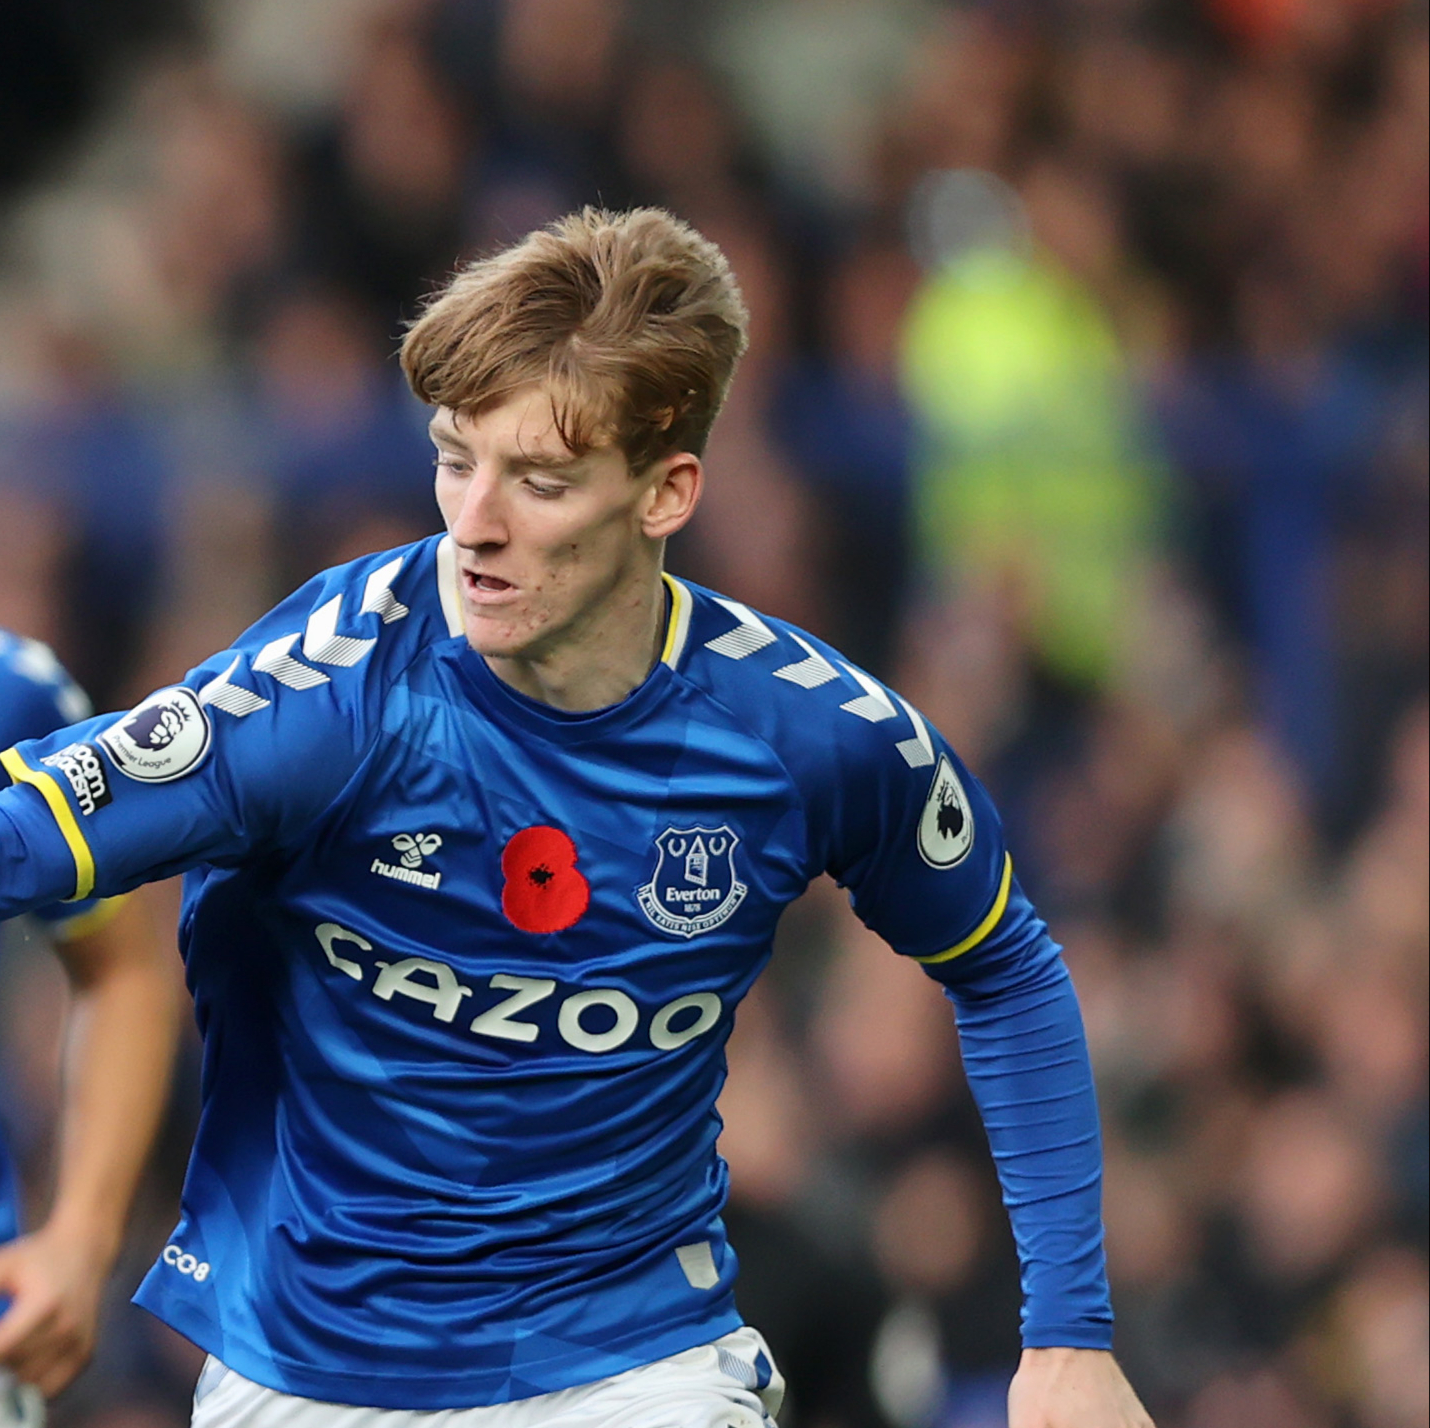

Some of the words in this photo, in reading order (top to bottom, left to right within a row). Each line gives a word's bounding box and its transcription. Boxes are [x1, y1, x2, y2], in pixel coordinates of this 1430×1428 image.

[370, 858, 441, 890] hummel
[666, 886, 721, 902] Everton
[314, 921, 722, 1053] CAZOO
